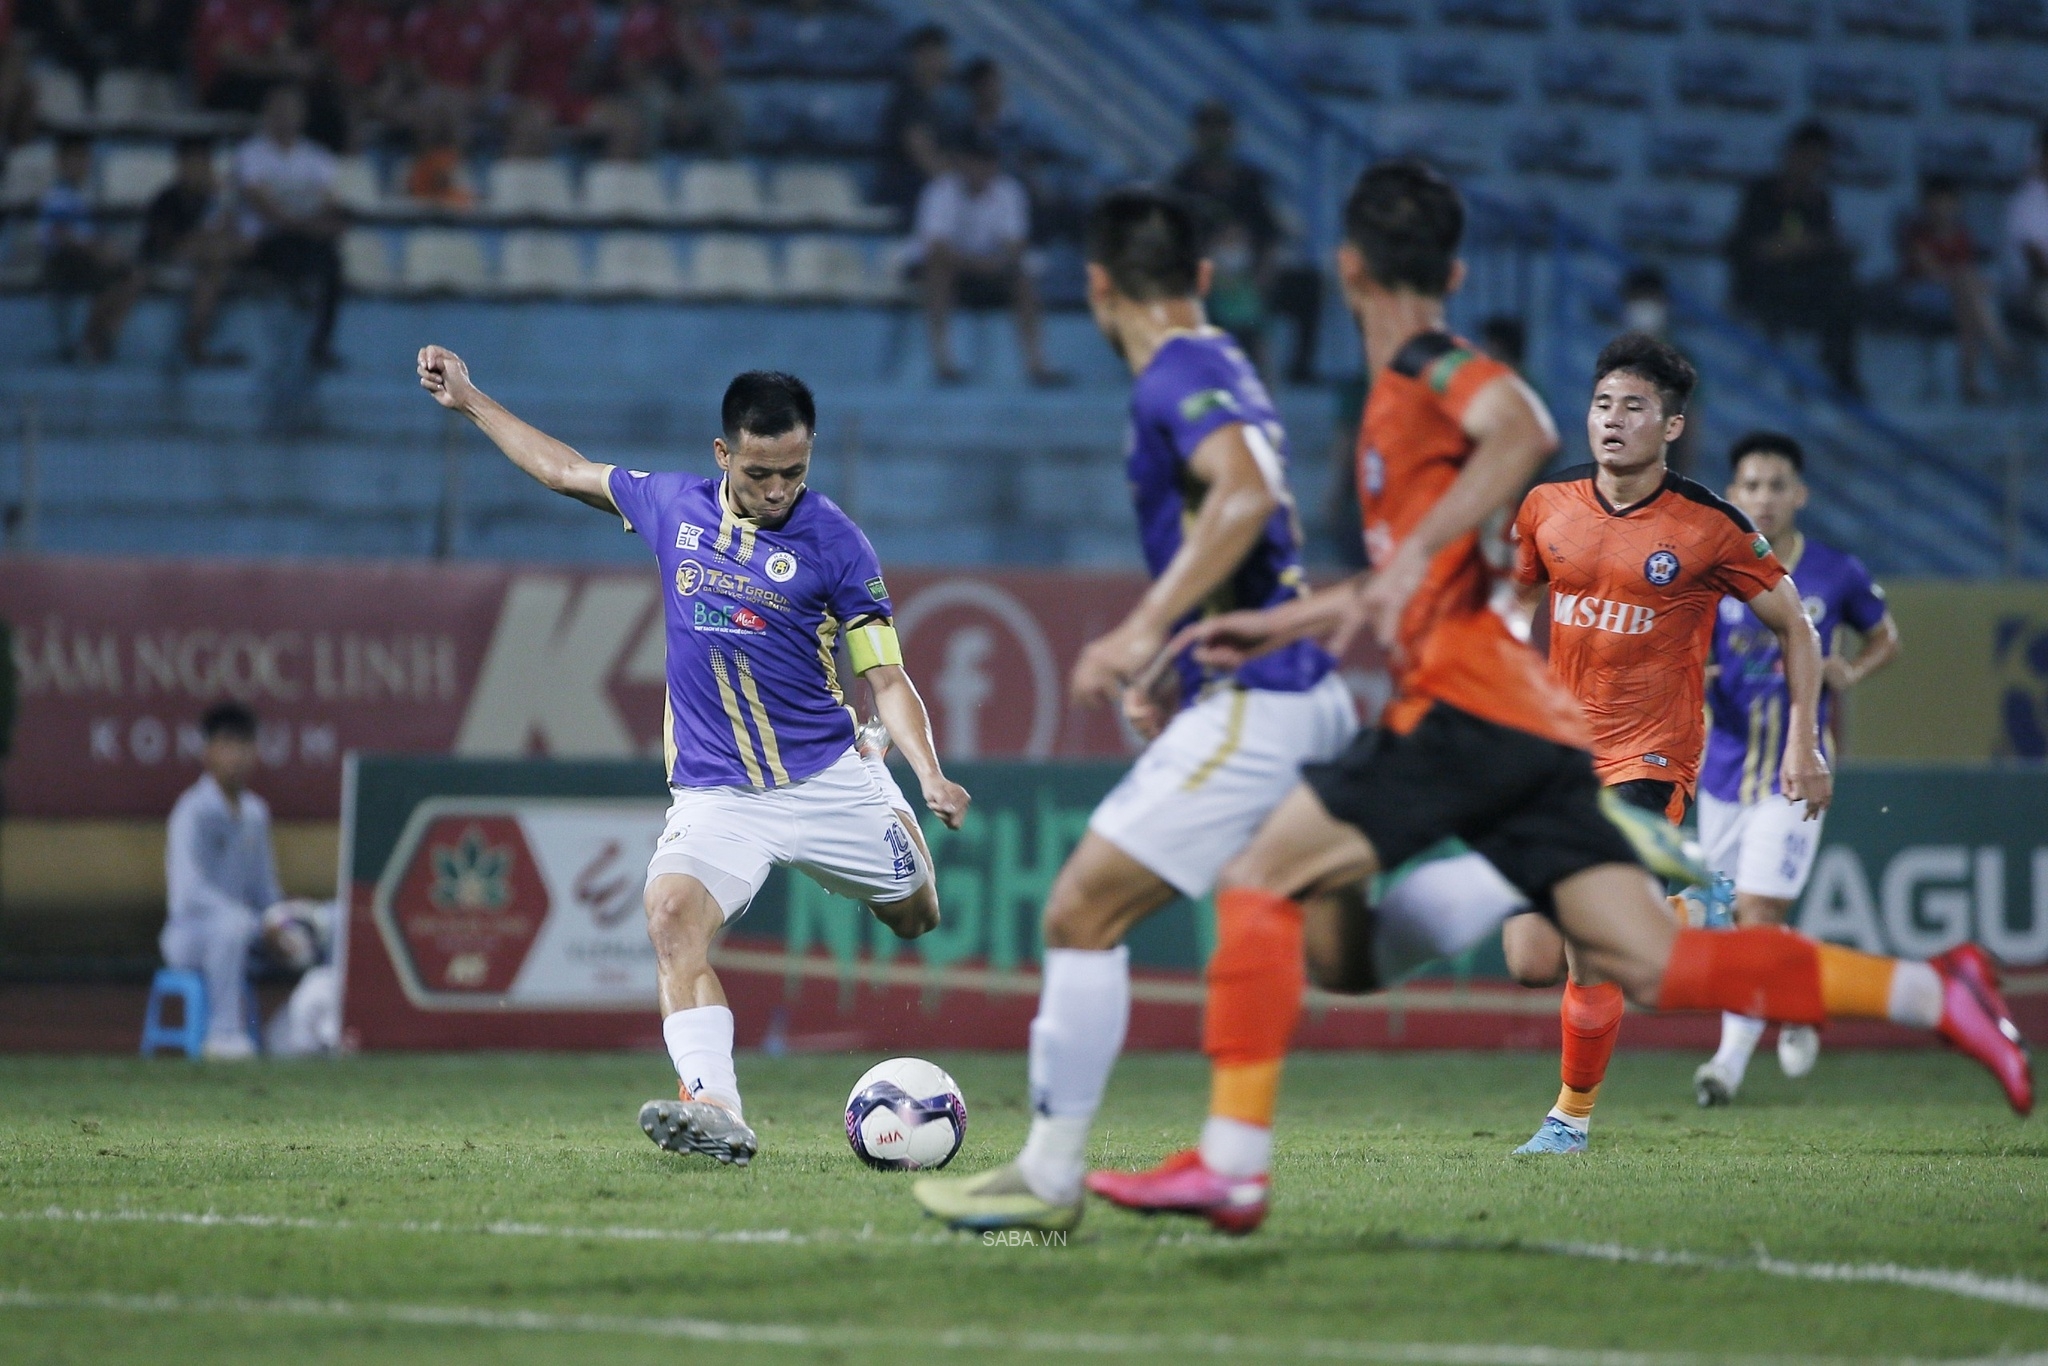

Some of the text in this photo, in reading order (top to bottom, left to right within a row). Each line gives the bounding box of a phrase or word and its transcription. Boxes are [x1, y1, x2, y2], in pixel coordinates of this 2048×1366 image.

[681, 525, 701, 537] JG
[678, 536, 697, 548] BL
[706, 568, 752, 593] T&T
[693, 601, 735, 626] BaF
[883, 821, 909, 858] 10
[876, 1131, 904, 1145] VPF
